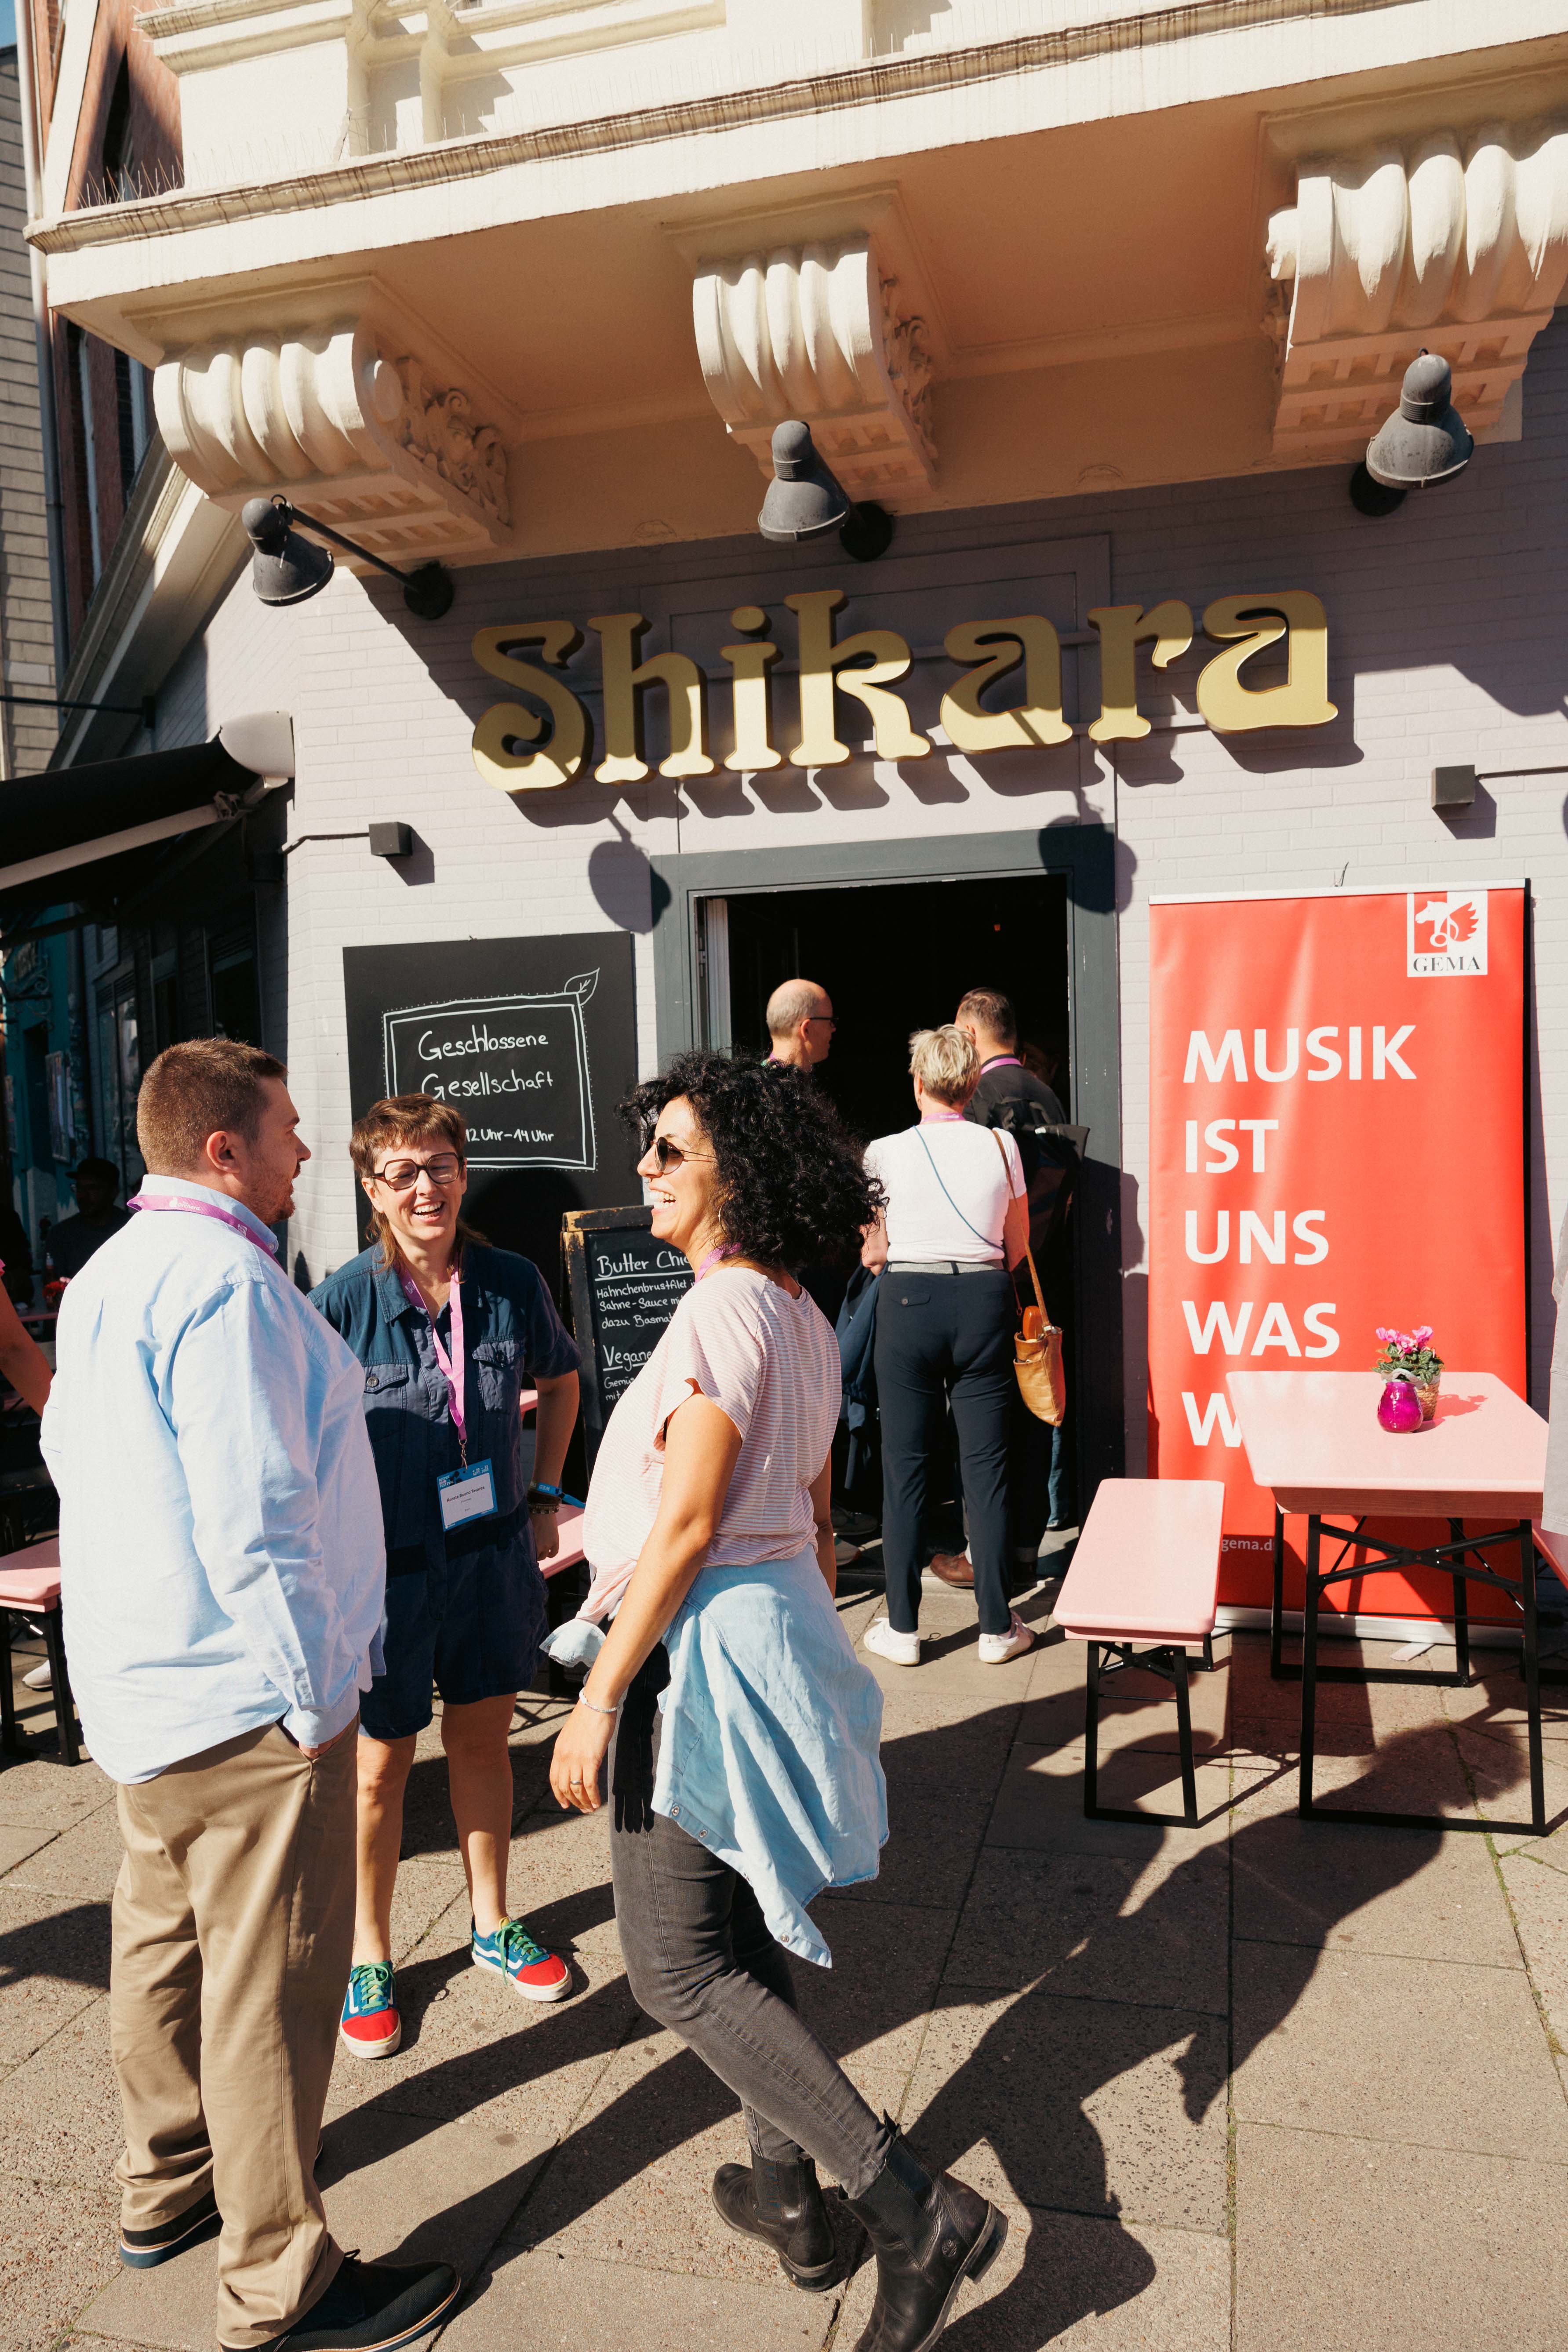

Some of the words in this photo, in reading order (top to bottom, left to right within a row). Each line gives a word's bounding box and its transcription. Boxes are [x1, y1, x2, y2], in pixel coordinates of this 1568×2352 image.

[471, 589, 1339, 793] Shikara
[1413, 956, 1481, 972] GEMA
[418, 1024, 549, 1061] Geschlossene
[1183, 1025, 1417, 1083] MUSIK
[422, 1069, 553, 1100] Gesellschaft
[466, 1128, 480, 1142] 12
[531, 1130, 554, 1142] Uhr
[1186, 1119, 1279, 1173] IST
[1185, 1210, 1329, 1265] UNS
[597, 1253, 649, 1277] Butter
[597, 1280, 687, 1299] Hähnchenbrustfilet
[602, 1317, 630, 1329] dazu
[633, 1312, 674, 1327] Basmat
[1182, 1301, 1339, 1358] WAS
[1182, 1392, 1242, 1447] W
